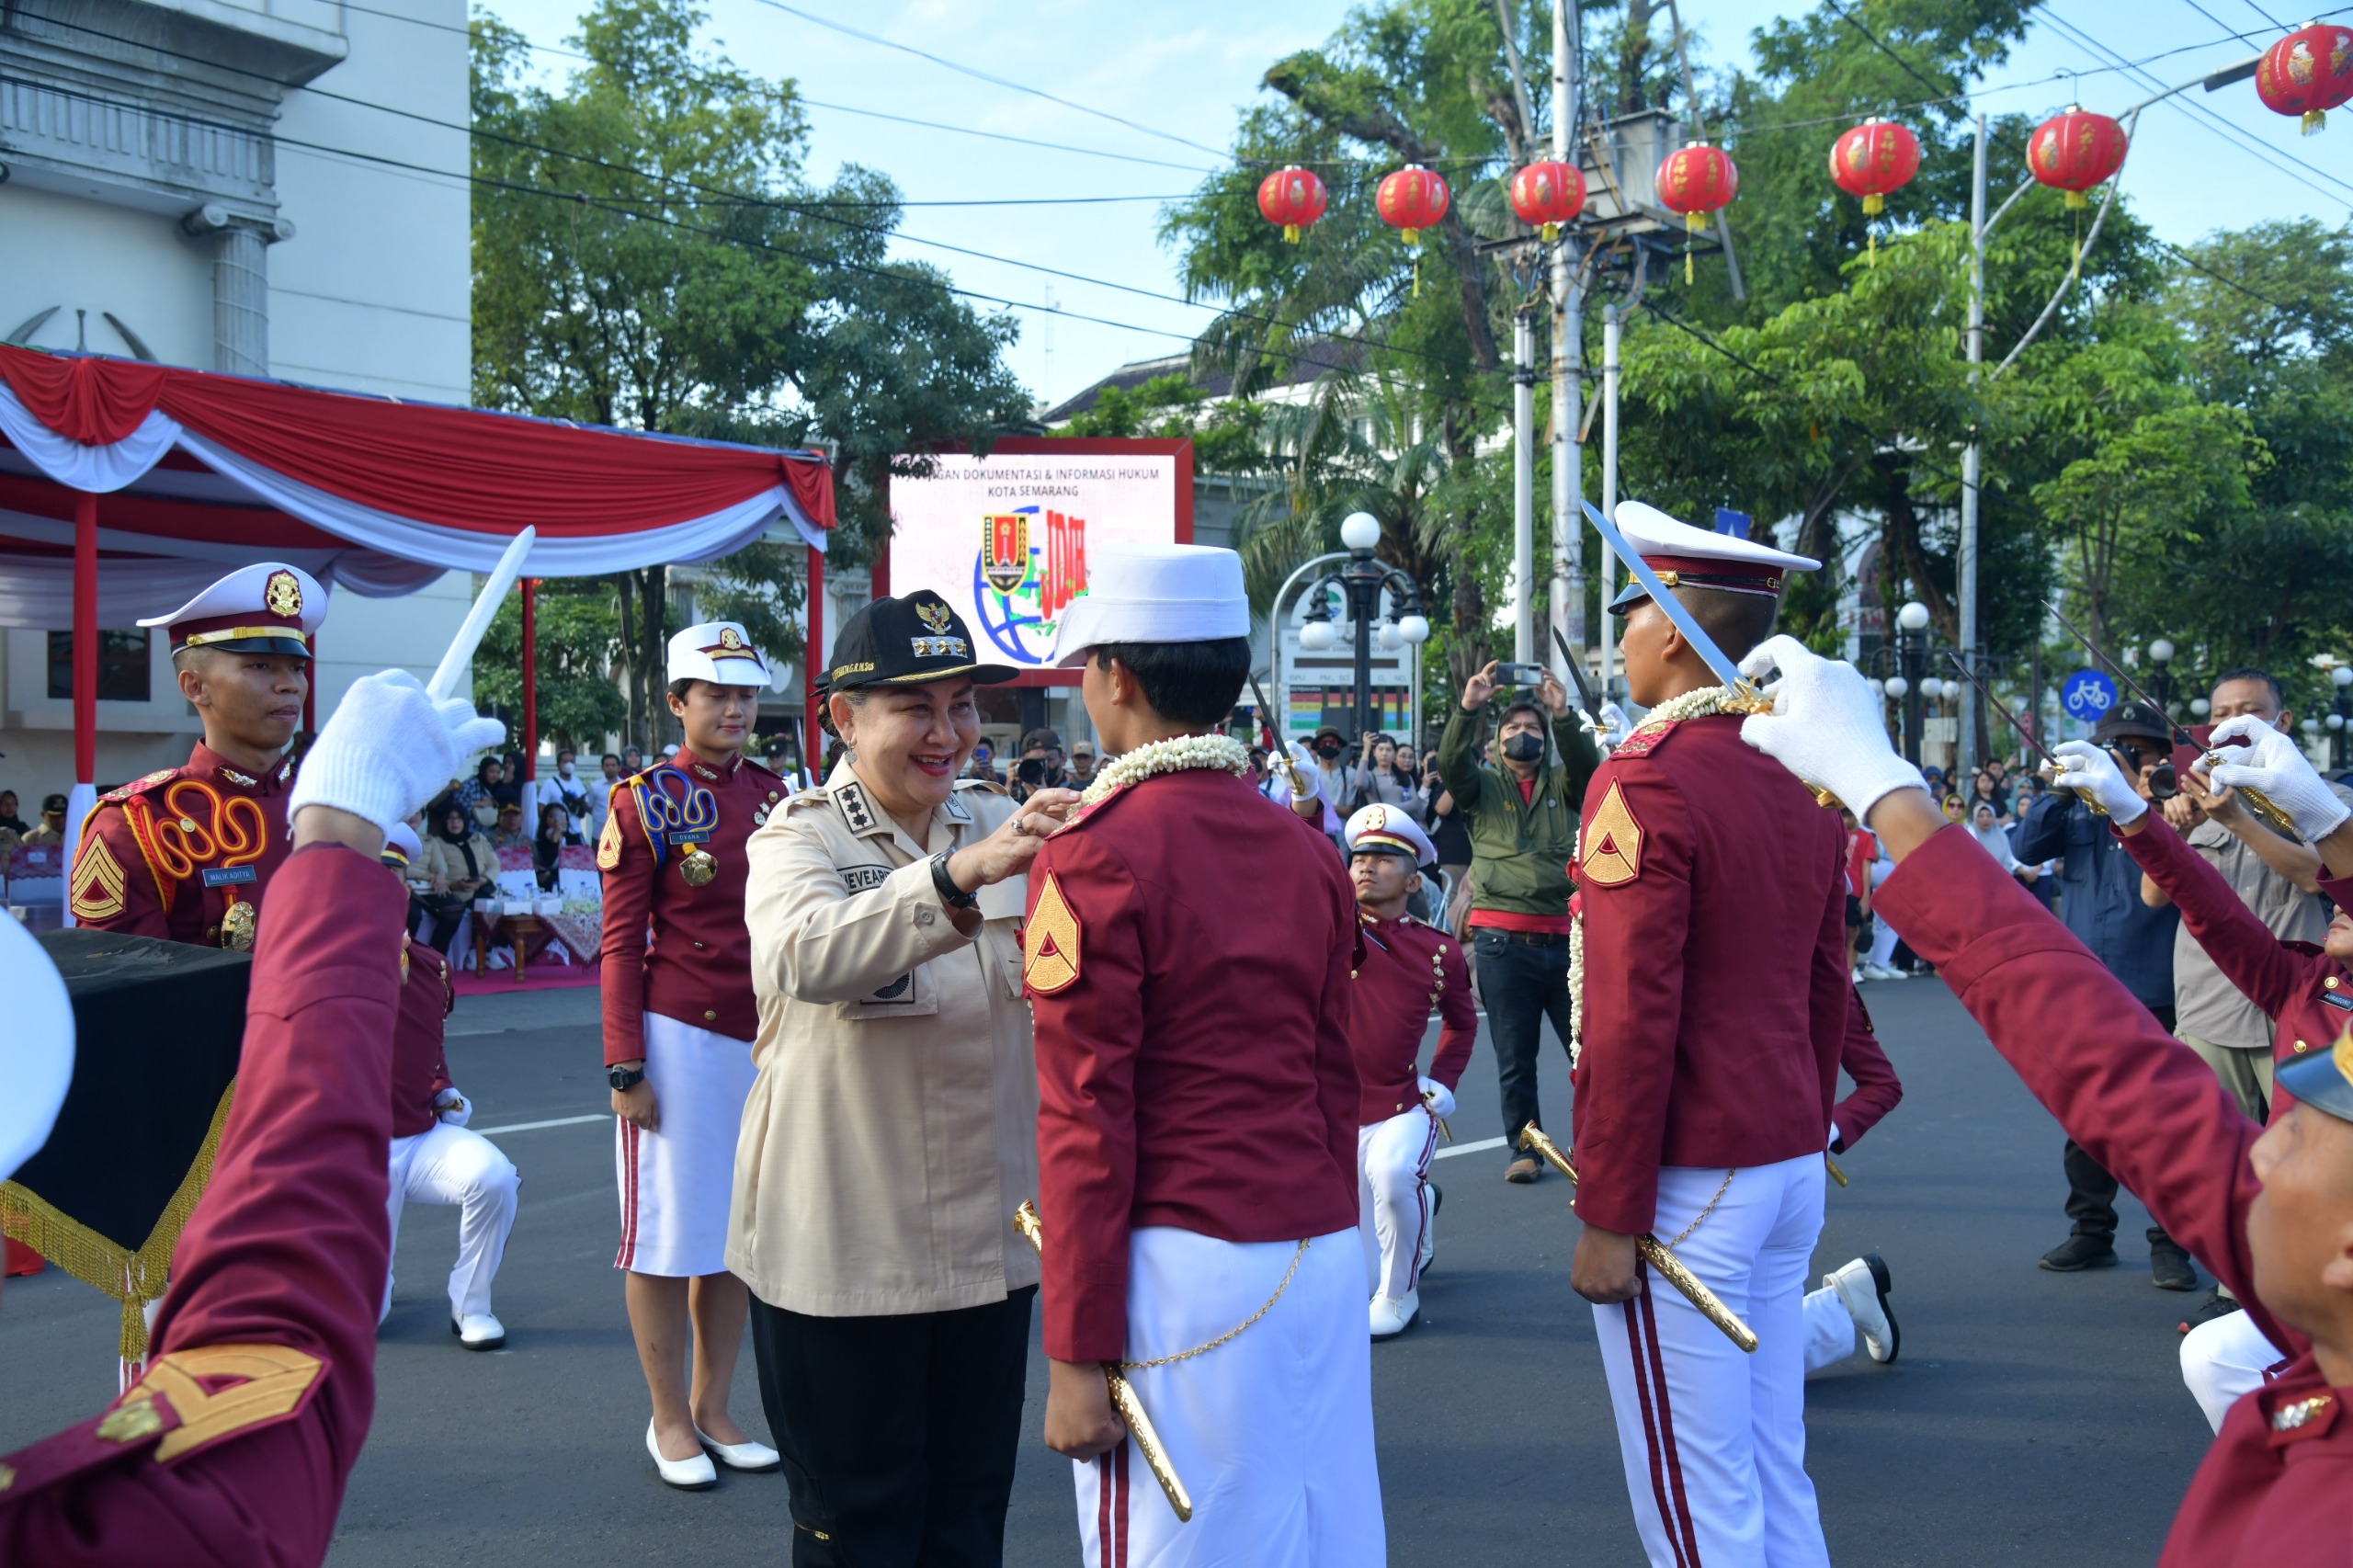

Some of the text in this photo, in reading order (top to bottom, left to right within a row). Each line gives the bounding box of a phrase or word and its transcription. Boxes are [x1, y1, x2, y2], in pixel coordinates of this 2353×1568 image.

[964, 469, 1041, 480] DOKUMENTASI
[1045, 470, 1052, 480] &
[1056, 469, 1115, 480] INFORMASI
[1119, 468, 1159, 480] HUKUM
[988, 485, 1078, 497] KOTA SEMARANG
[230, 871, 250, 880] ADITYA
